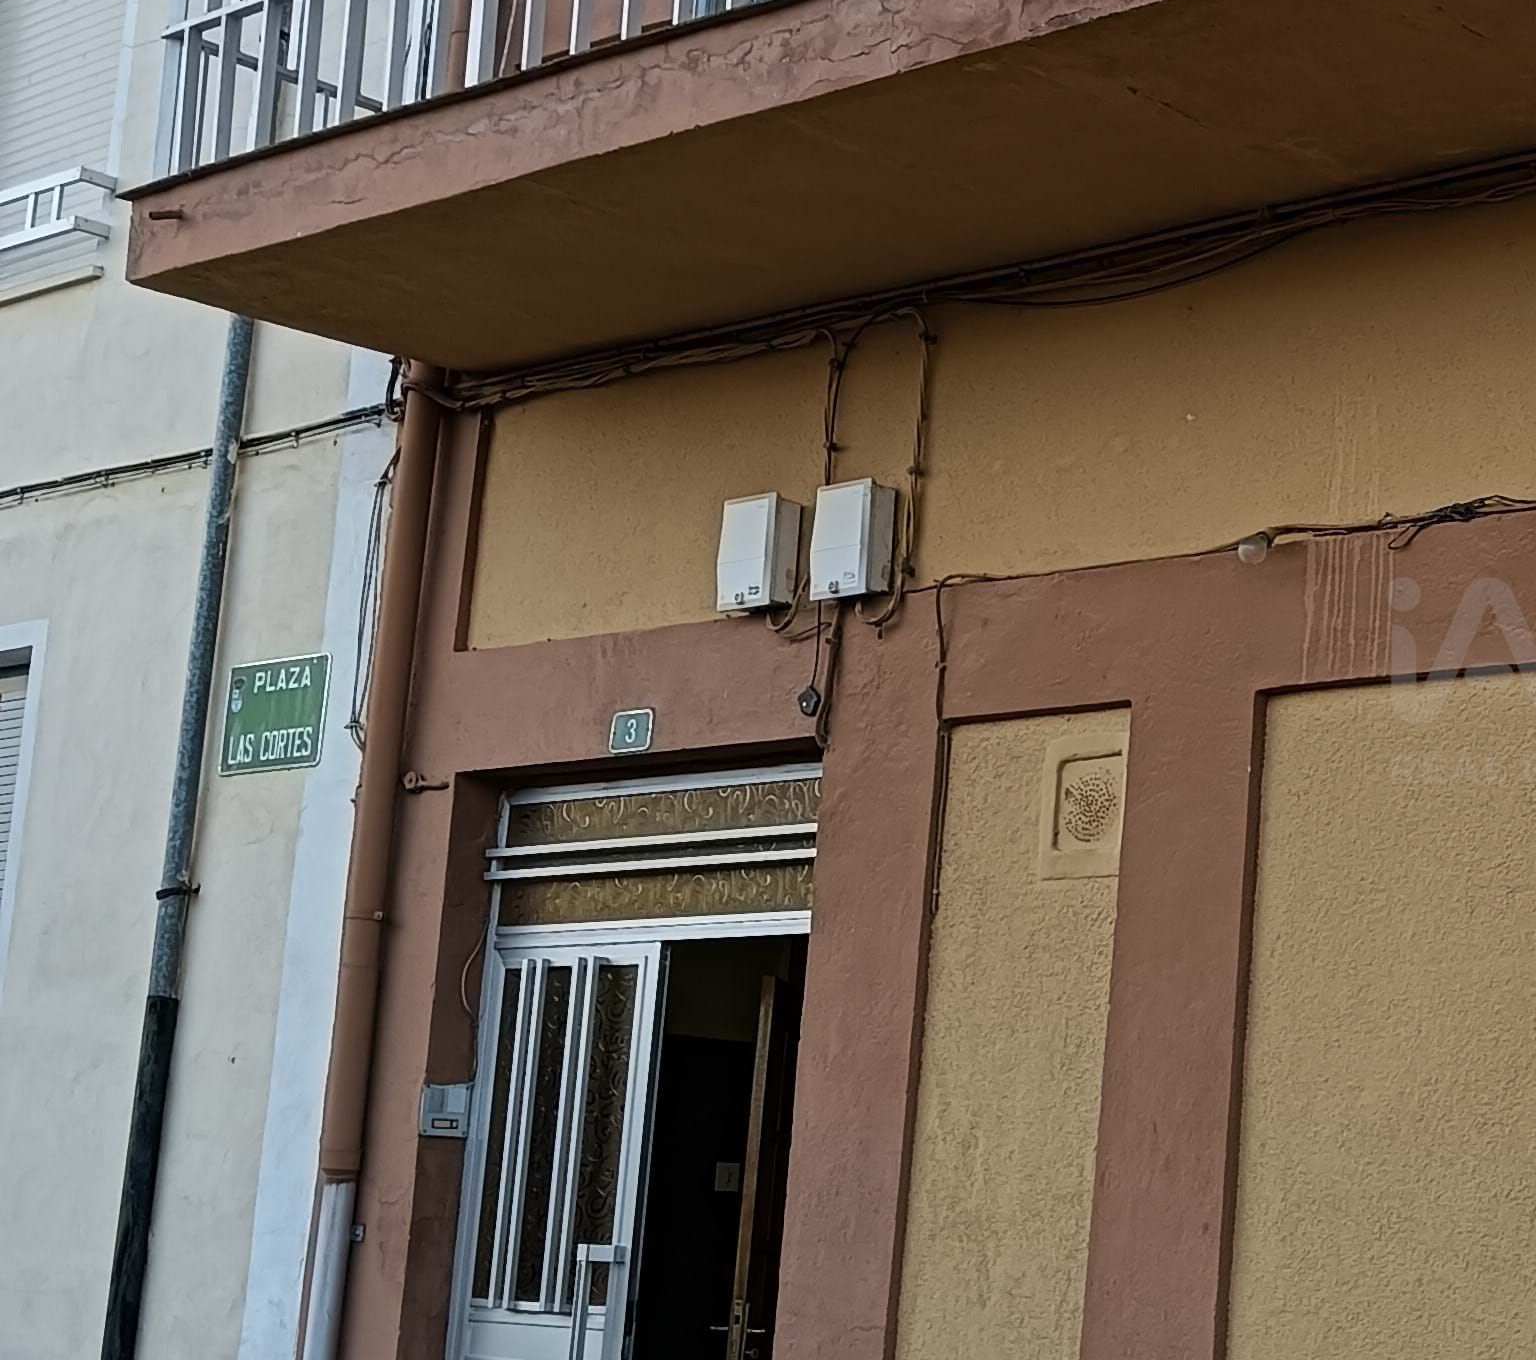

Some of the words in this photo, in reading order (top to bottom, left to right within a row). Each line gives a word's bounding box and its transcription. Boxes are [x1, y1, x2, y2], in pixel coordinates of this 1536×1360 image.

[254, 665, 311, 693] PLAZA
[625, 719, 637, 743] 3
[228, 733, 254, 765] LAS
[260, 727, 313, 761] CORTES
